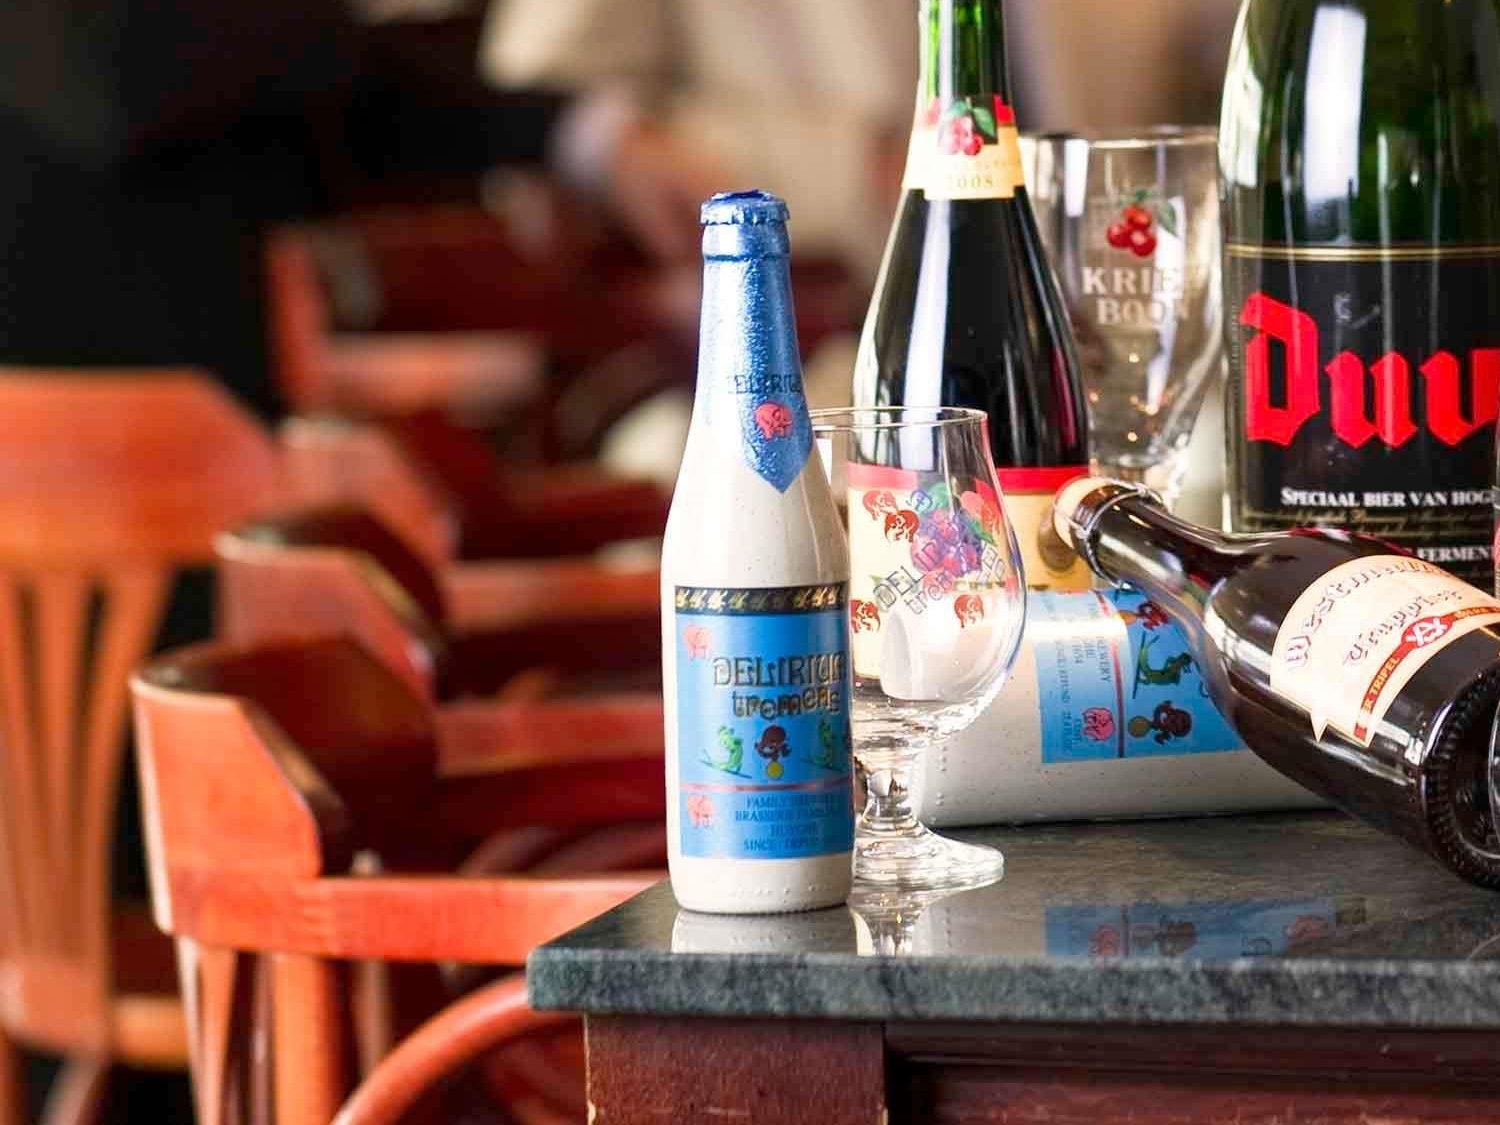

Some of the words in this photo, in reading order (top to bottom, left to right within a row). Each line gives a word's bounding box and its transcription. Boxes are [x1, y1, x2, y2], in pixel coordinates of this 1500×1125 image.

[1082, 267, 1190, 294] KRIE
[1363, 491, 1405, 508] BIER
[1409, 491, 1448, 507] VAN
[1367, 656, 1401, 694] TRIPEL
